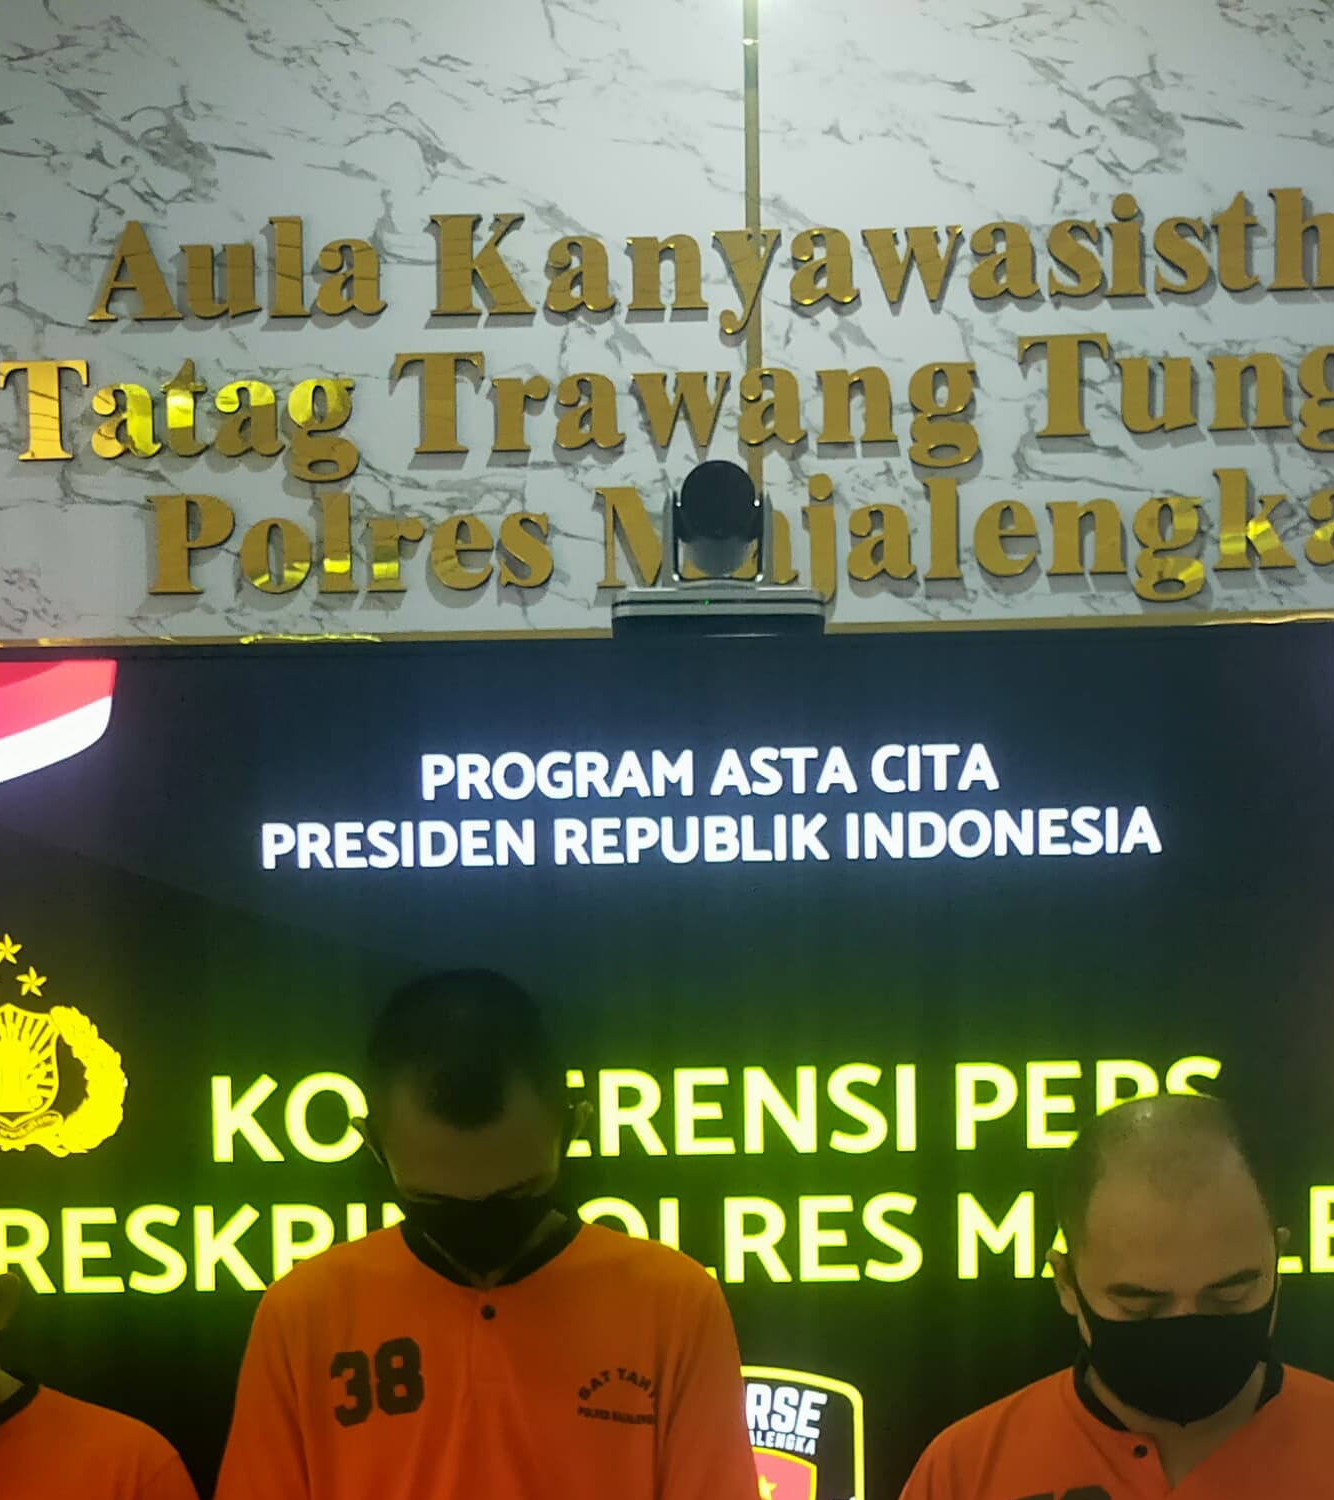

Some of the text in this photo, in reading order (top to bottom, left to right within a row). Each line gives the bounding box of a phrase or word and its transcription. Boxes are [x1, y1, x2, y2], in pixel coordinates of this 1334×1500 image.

[88, 216, 387, 324] Aula
[387, 348, 979, 468] Trawang
[146, 492, 553, 597] Polres
[420, 743, 1000, 801] PROGRAM ASTA CITA
[260, 805, 1164, 870] PRESIDEN REPUBLIK INDONESIA
[210, 1064, 917, 1164] KORENSI
[329, 1336, 426, 1428] 38
[744, 1383, 828, 1439] RSE
